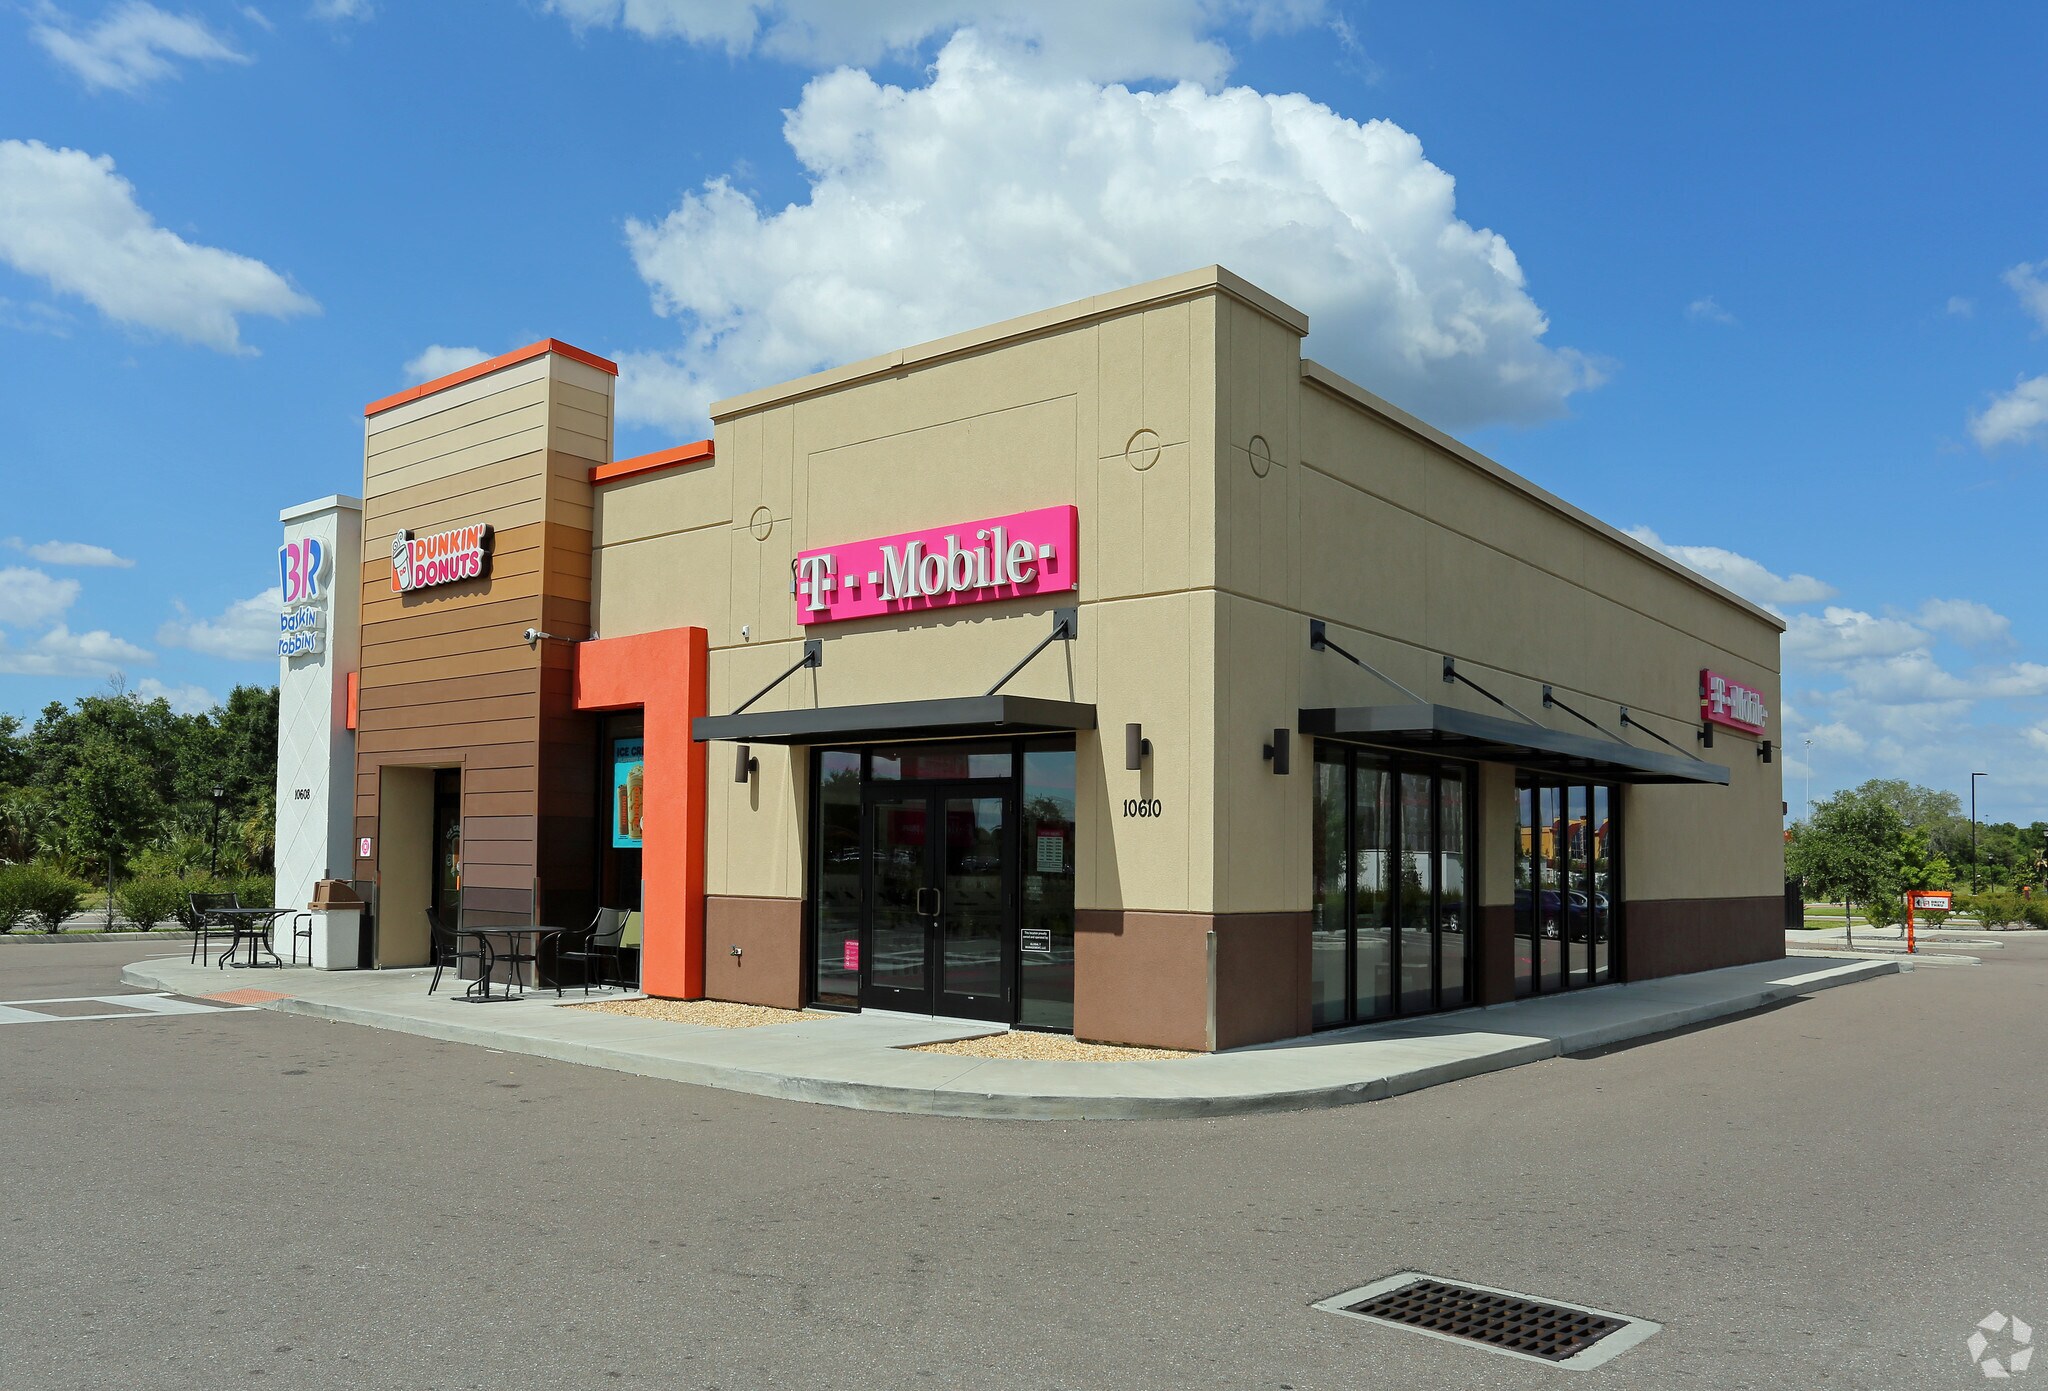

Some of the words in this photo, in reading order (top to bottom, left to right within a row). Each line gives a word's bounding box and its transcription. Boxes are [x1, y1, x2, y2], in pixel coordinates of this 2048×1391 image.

[415, 524, 483, 562] DUNKIN'
[279, 537, 321, 602] BR
[415, 550, 479, 587] DONUTS
[294, 788, 311, 800] 10608
[1123, 798, 1162, 818] 10610
